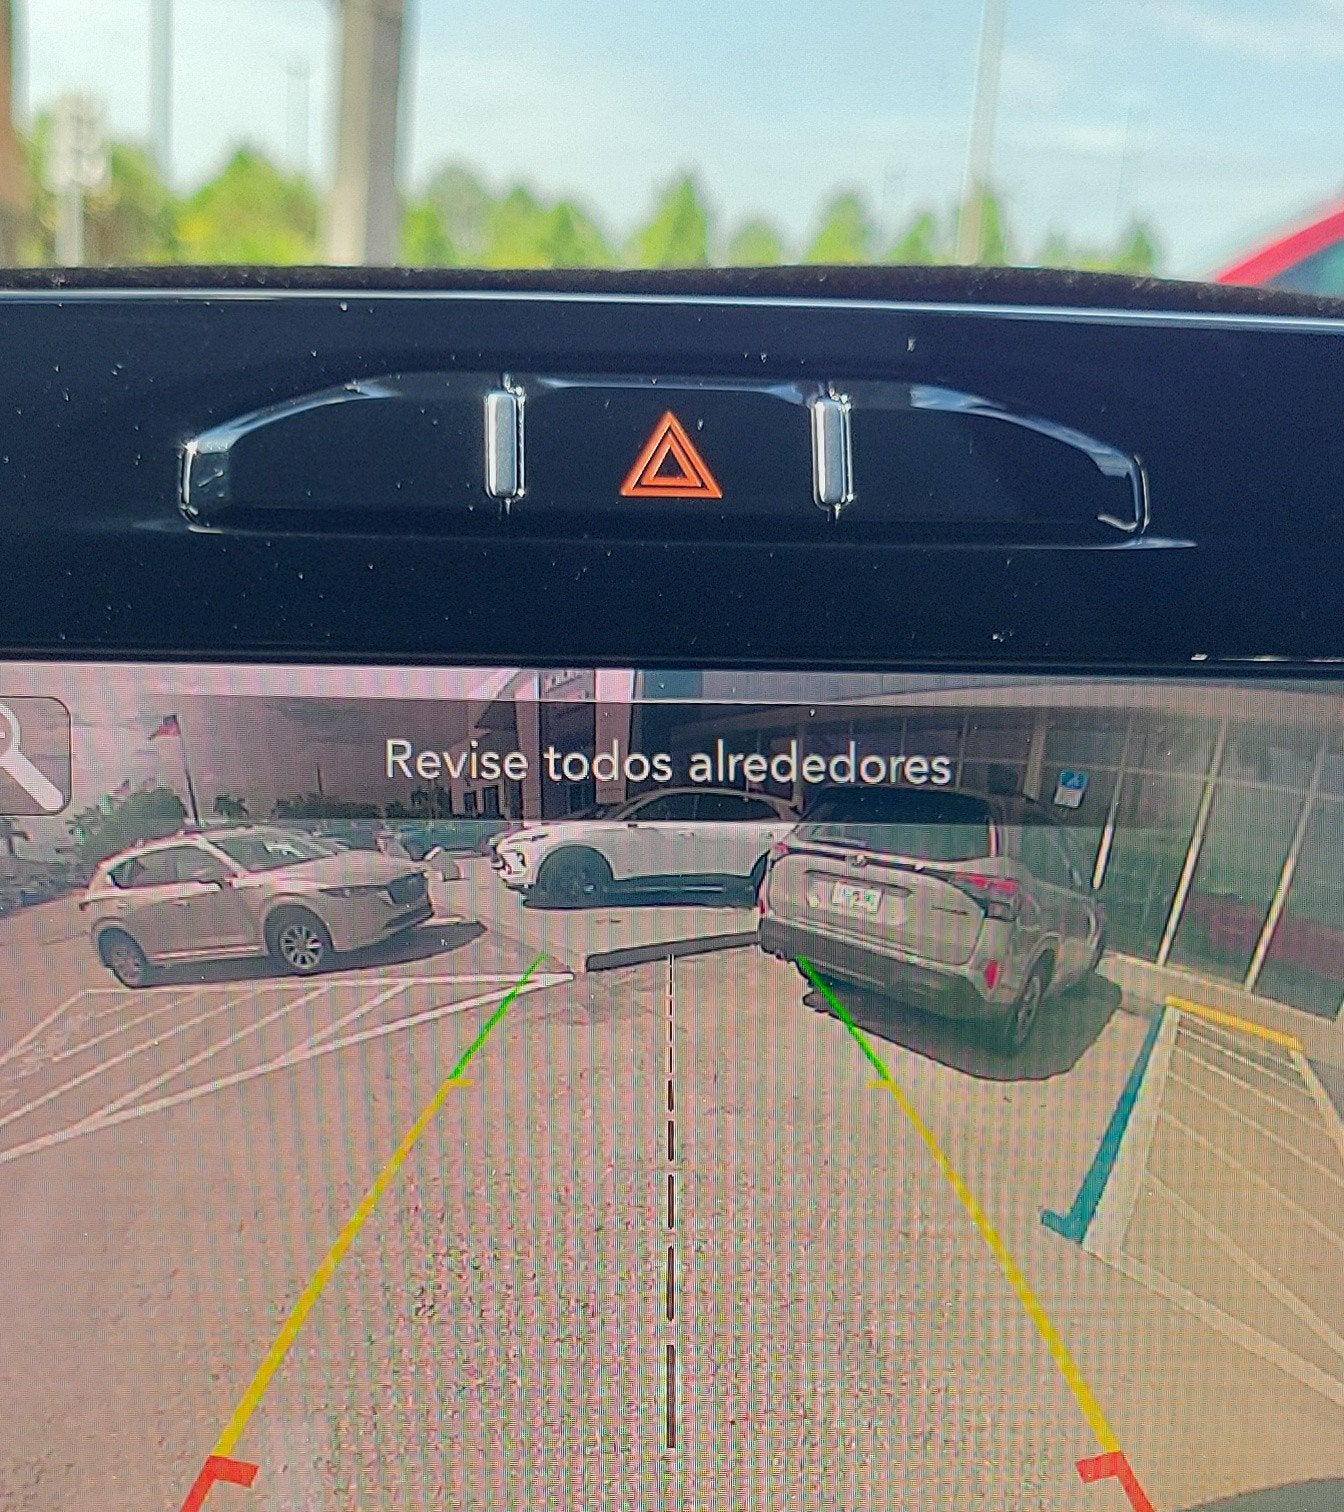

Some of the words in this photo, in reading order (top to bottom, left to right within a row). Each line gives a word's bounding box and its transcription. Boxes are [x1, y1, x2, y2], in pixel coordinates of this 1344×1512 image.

[384, 738, 529, 785] Revise
[542, 738, 674, 788] todos
[688, 738, 954, 792] alrededores
